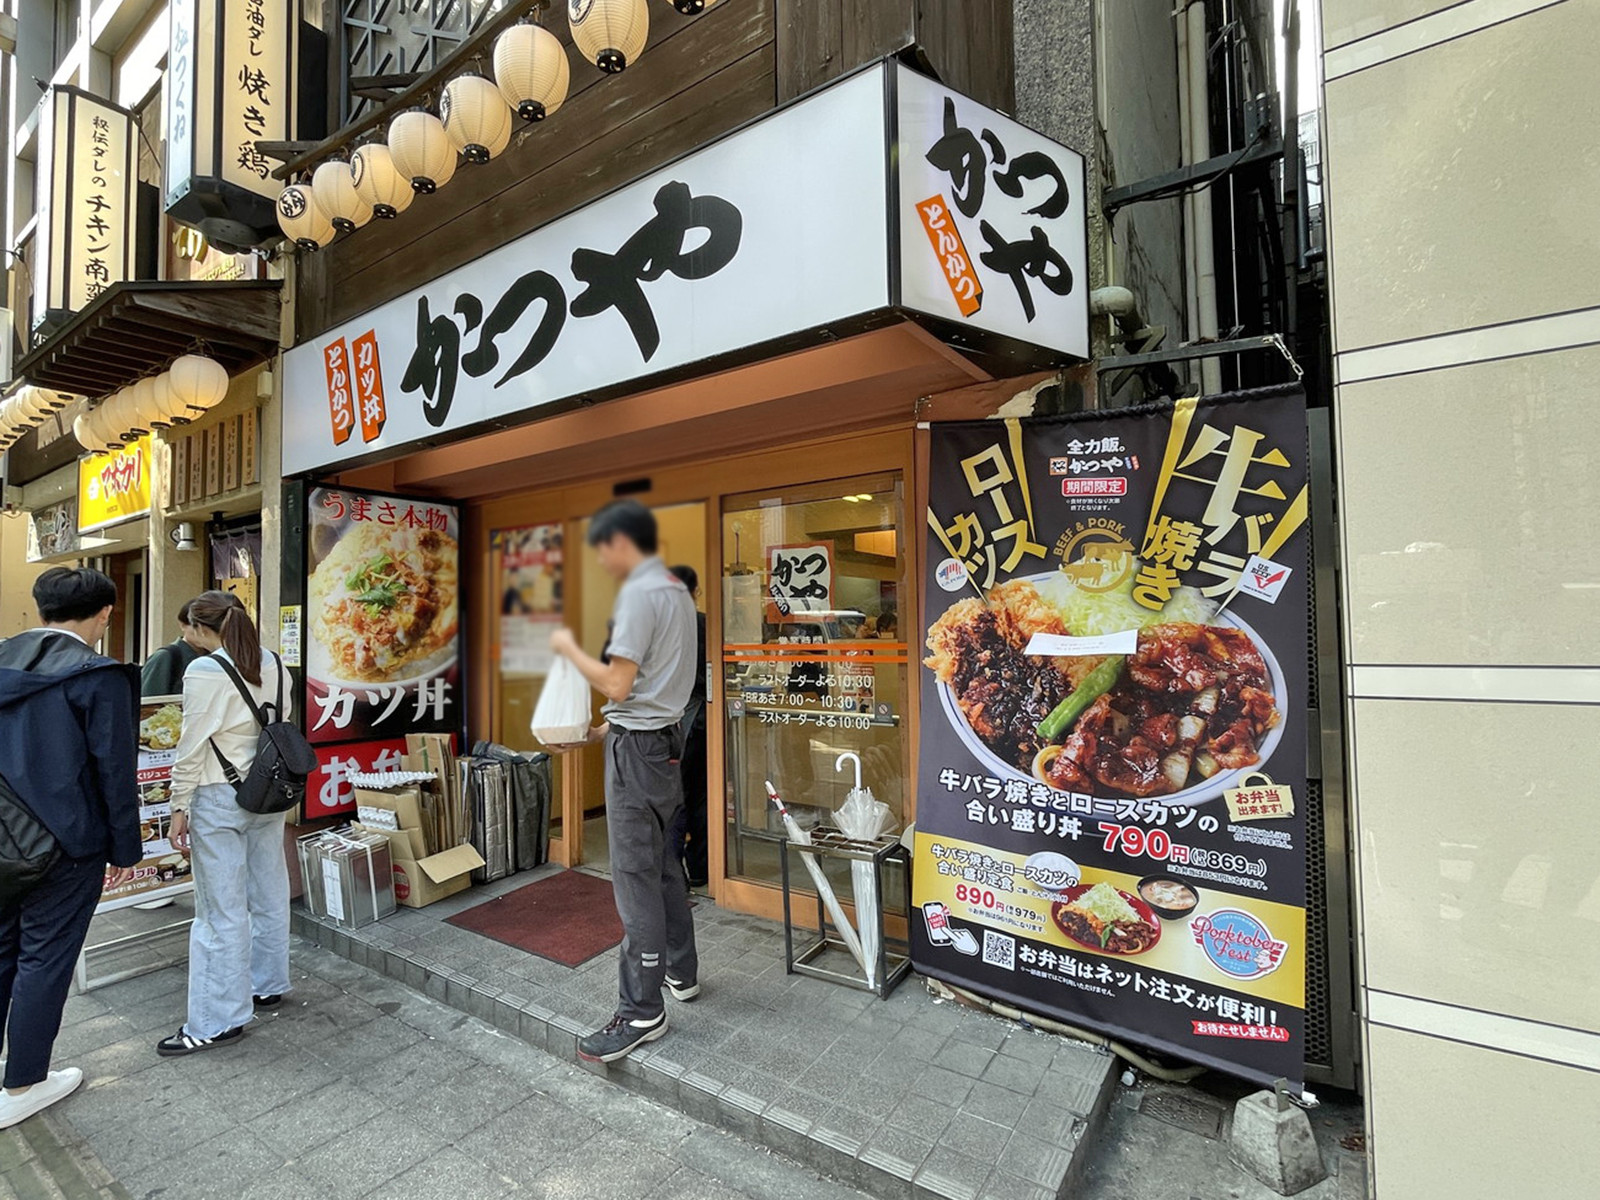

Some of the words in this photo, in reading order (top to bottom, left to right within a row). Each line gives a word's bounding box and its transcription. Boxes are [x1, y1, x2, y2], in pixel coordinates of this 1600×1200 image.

[925, 96, 1073, 323] かつや
[923, 204, 974, 300] とんかつ
[400, 180, 743, 427] かつや
[328, 346, 349, 430] とんかつ
[358, 342, 381, 426] カツ丼
[1067, 437, 1126, 454] 全力飯。
[1069, 456, 1123, 474] かつや
[1066, 480, 1122, 494] 期間限定
[323, 492, 448, 532] うまさ本物
[1052, 527, 1074, 556] BEEF
[1075, 521, 1085, 532] &
[1087, 517, 1126, 535] PORK
[312, 678, 452, 732] カツ丼
[939, 768, 1218, 834] 牛バラ焼きとロースカツの
[1235, 789, 1280, 804] お弁当
[965, 801, 1082, 842] 合い盛り丼
[931, 843, 1079, 888] 牛バラ焼きとロースカツの
[937, 860, 1015, 893] 合い盛り定食
[1213, 938, 1251, 962] Fest
[1018, 944, 1277, 1028] お弁当はネット注文が便利!
[1197, 1022, 1285, 1040] お待たせしません!
